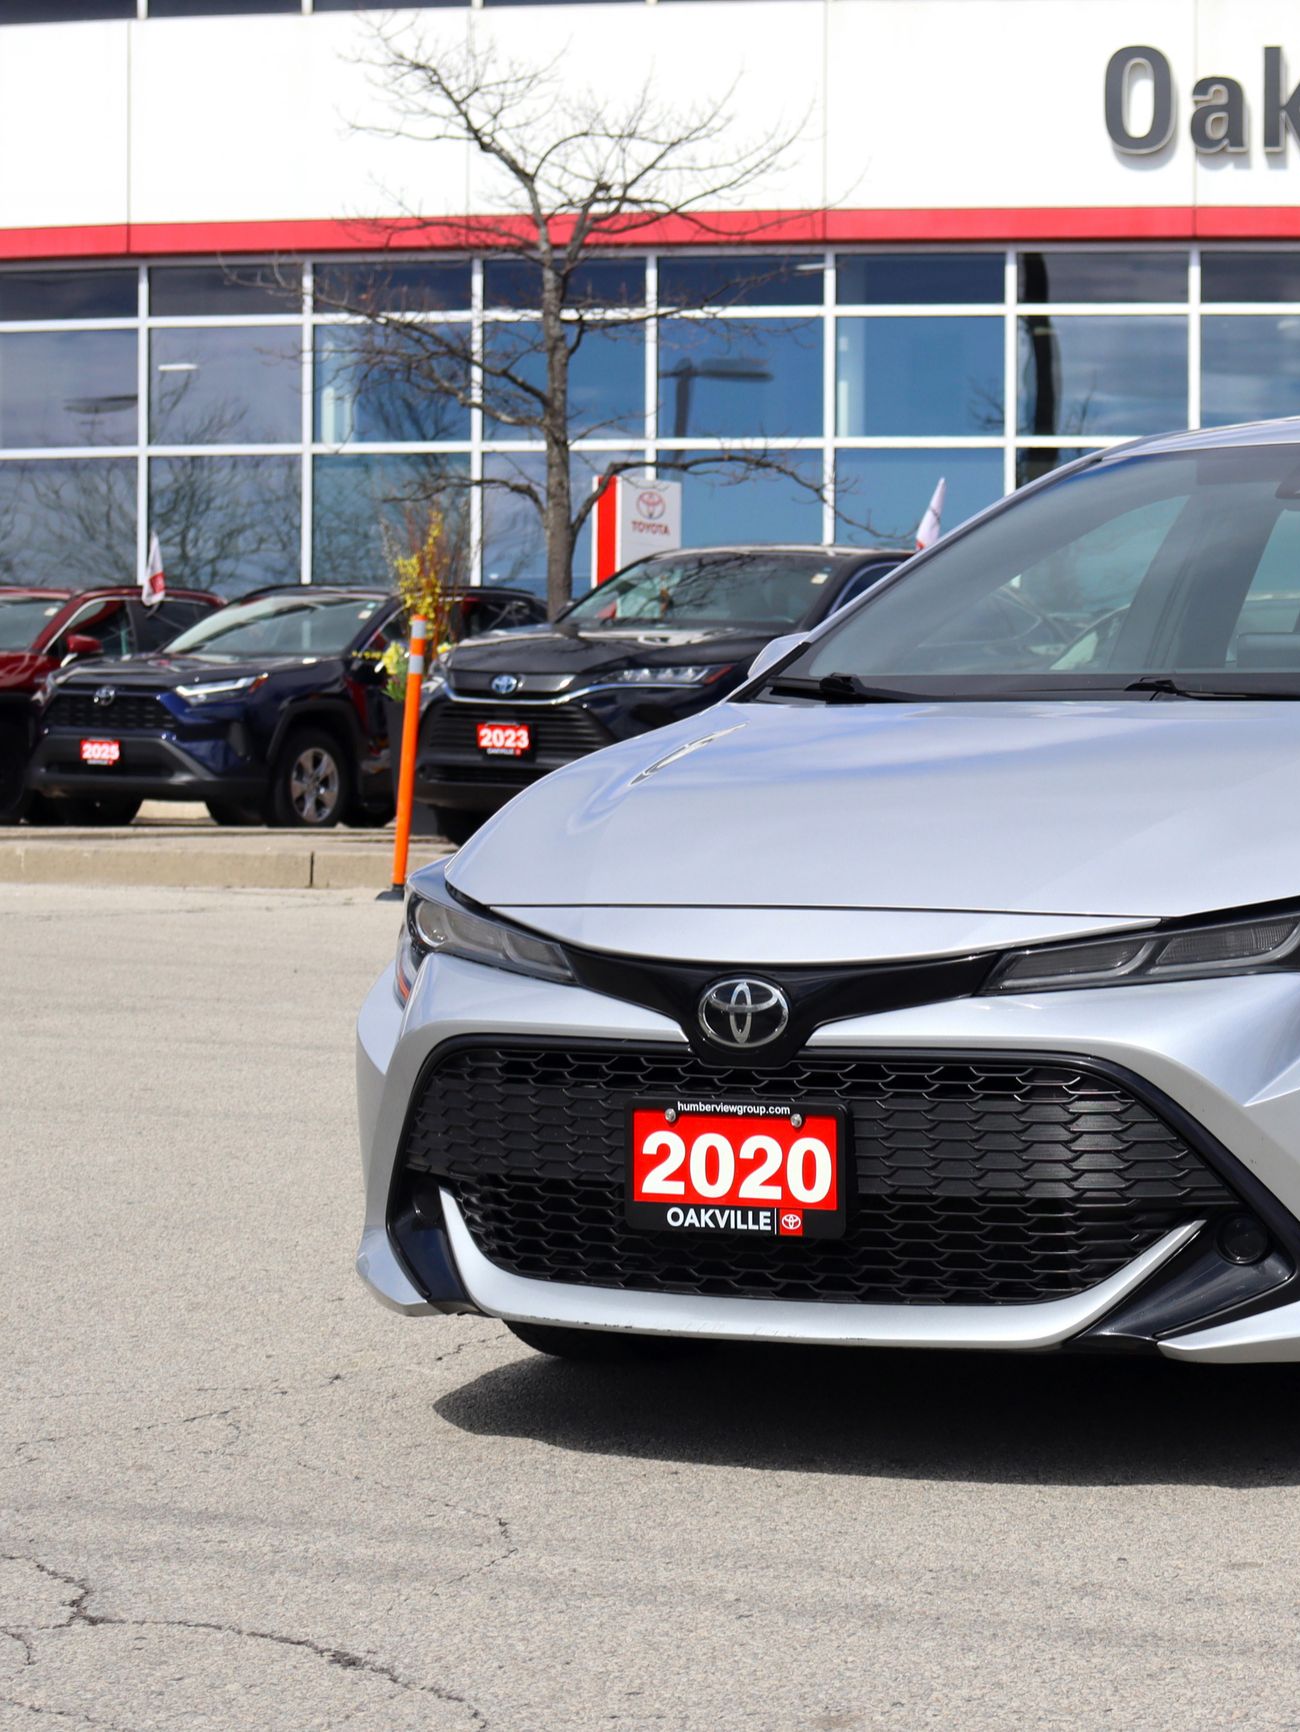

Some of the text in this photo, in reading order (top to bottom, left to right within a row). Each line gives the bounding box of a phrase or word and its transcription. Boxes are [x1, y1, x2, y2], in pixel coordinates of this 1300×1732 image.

[631, 521, 671, 535] TOYOTA
[480, 728, 529, 749] 2023
[677, 1101, 790, 1116] humberviewgroup.com
[641, 1130, 832, 1203] 2020
[666, 1207, 771, 1231] OAKVILLE
